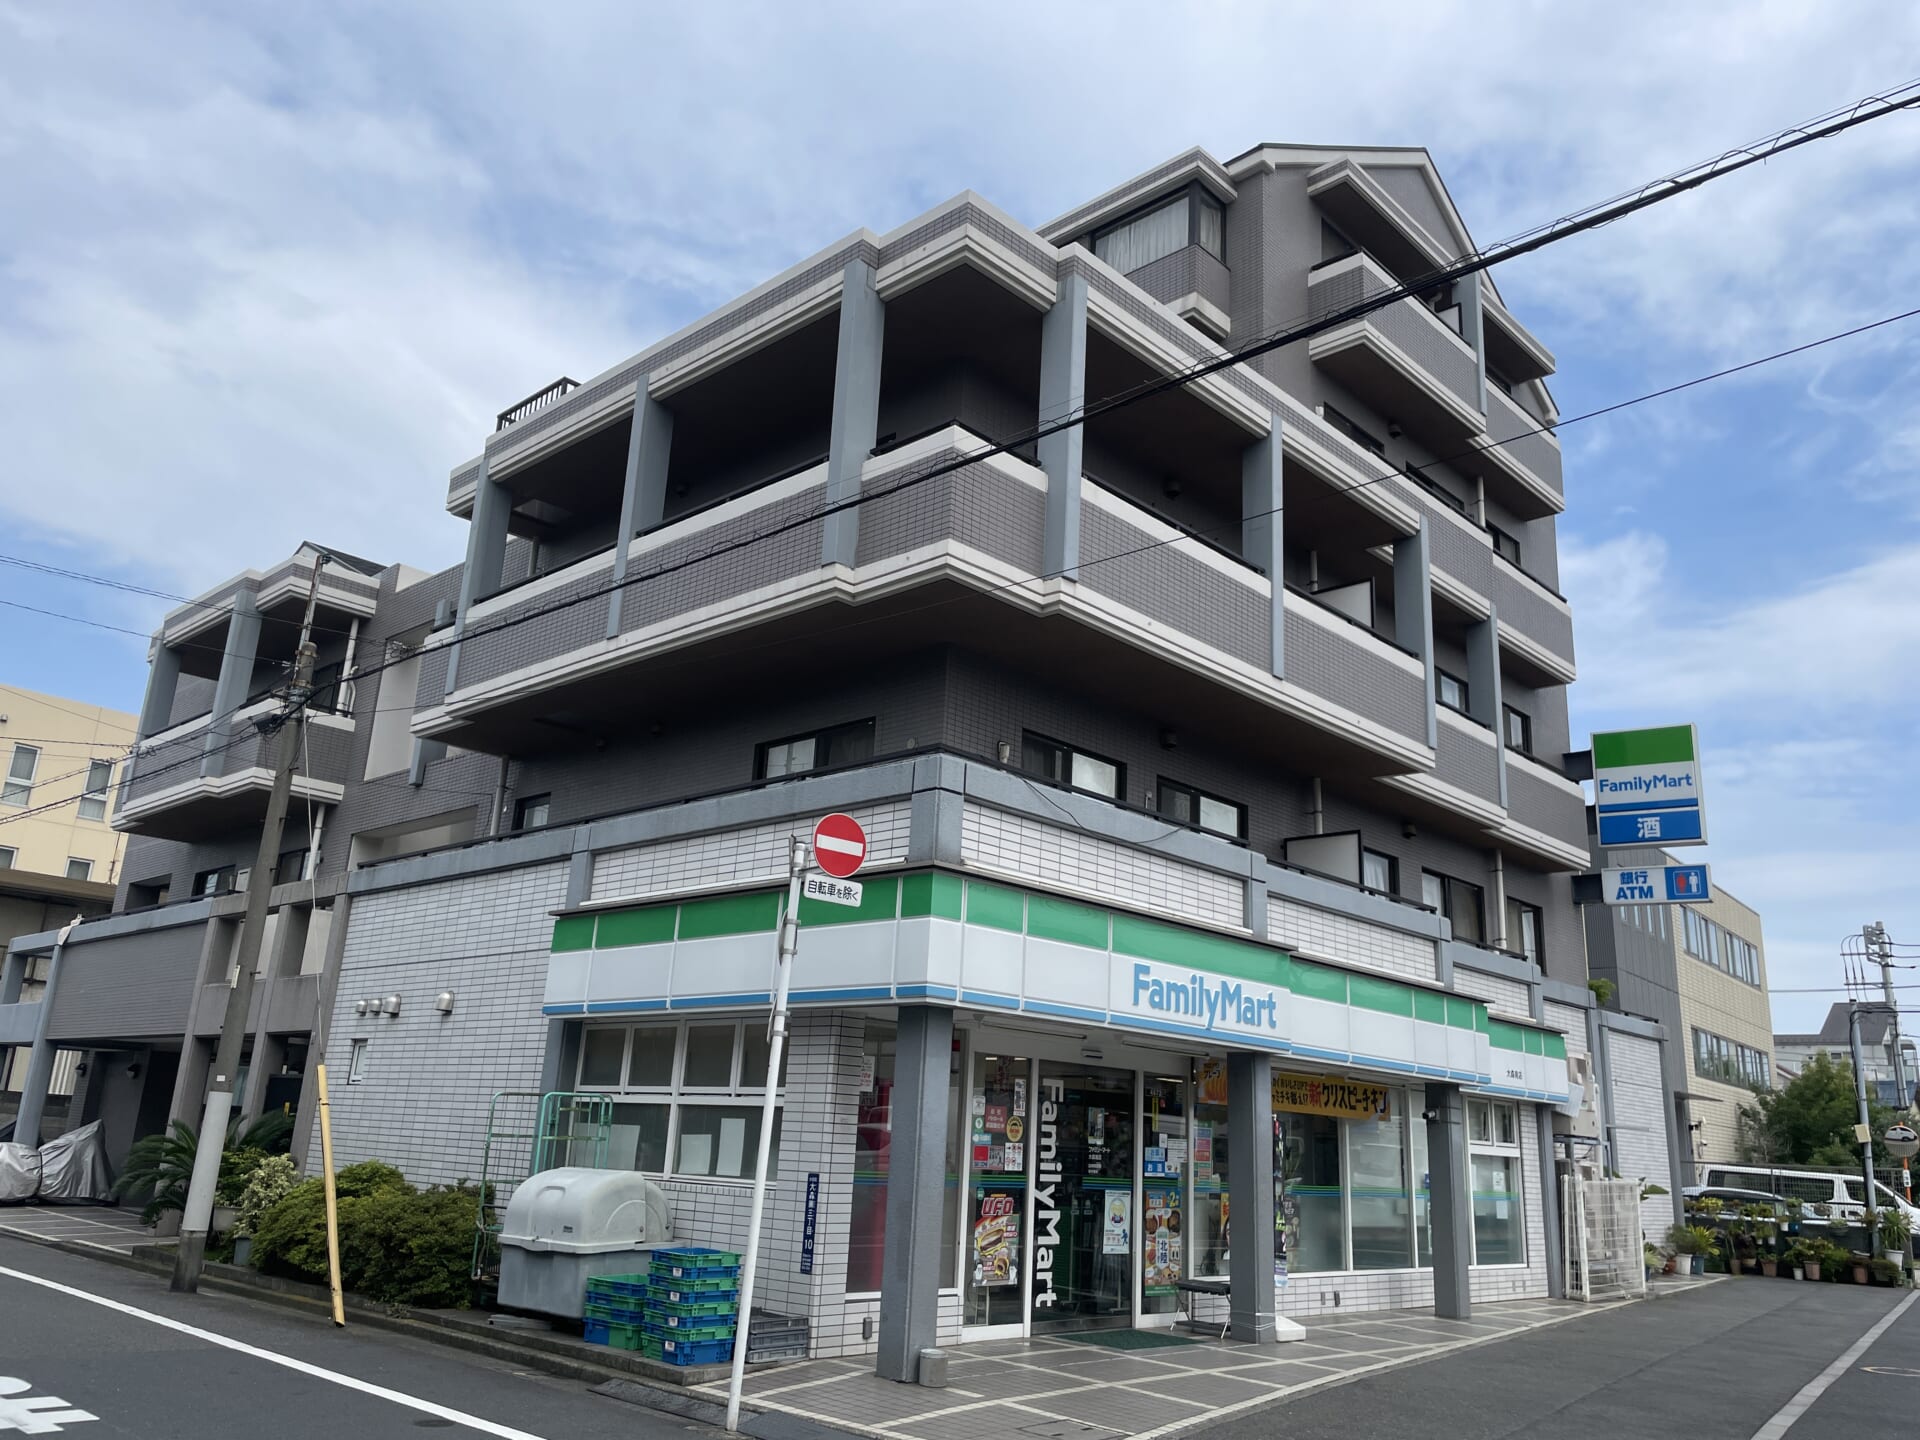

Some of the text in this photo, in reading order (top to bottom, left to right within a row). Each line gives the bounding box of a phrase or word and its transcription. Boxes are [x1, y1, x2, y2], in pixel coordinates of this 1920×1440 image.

[1599, 773, 1693, 793] FamilyMart
[1637, 817, 1661, 839] 酒
[1620, 871, 1649, 885] 銀行
[808, 880, 859, 902] 自転車を除く
[1616, 886, 1654, 900] ATM
[1133, 962, 1278, 1031] FamilyMart
[1034, 1078, 1065, 1309] FamilyMart
[981, 1197, 1014, 1217] UFO
[804, 1238, 813, 1250] 10
